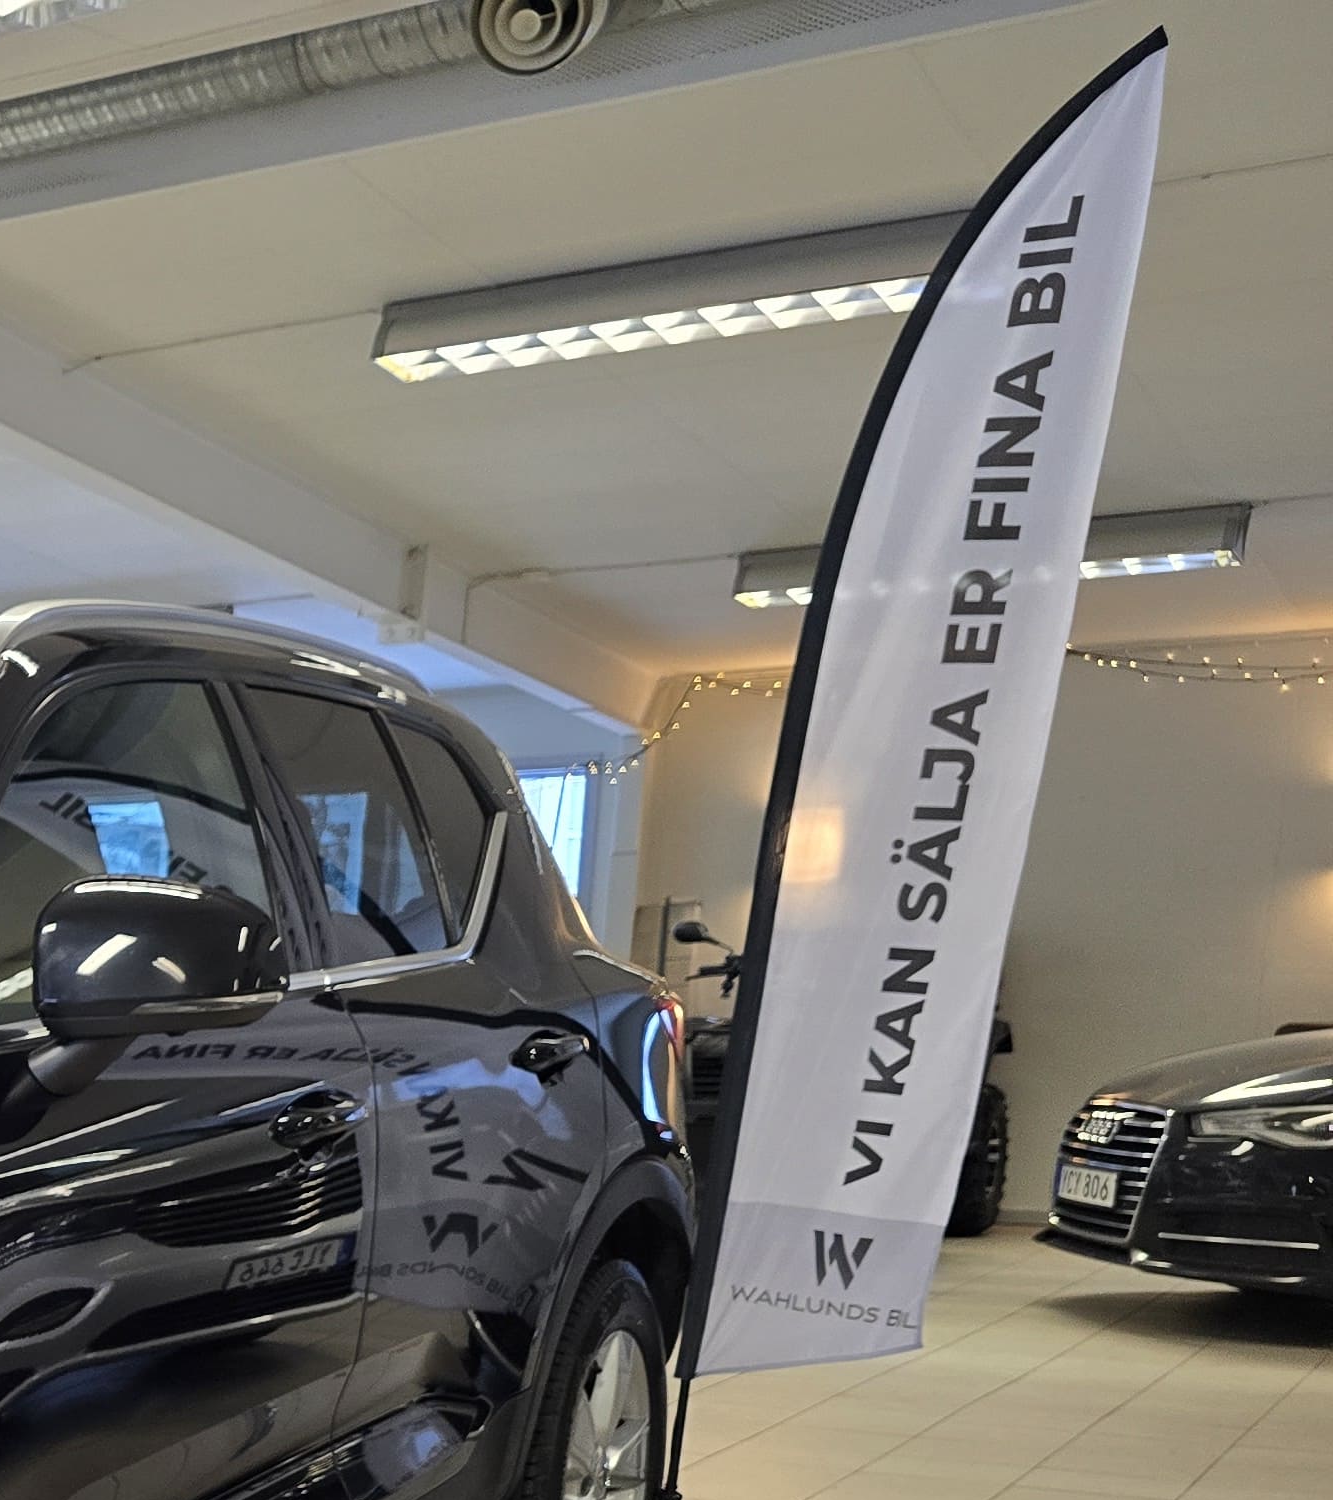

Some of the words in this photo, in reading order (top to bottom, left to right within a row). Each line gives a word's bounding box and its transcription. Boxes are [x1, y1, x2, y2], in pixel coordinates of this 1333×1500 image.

[1006, 194, 1085, 328] BIL
[963, 350, 1054, 540] FINA
[941, 568, 1013, 664] ER
[890, 688, 990, 924] SÄLJA
[862, 947, 936, 1096] KAN
[842, 1119, 894, 1186] VI
[731, 1284, 881, 1324] WAHLUNDS
